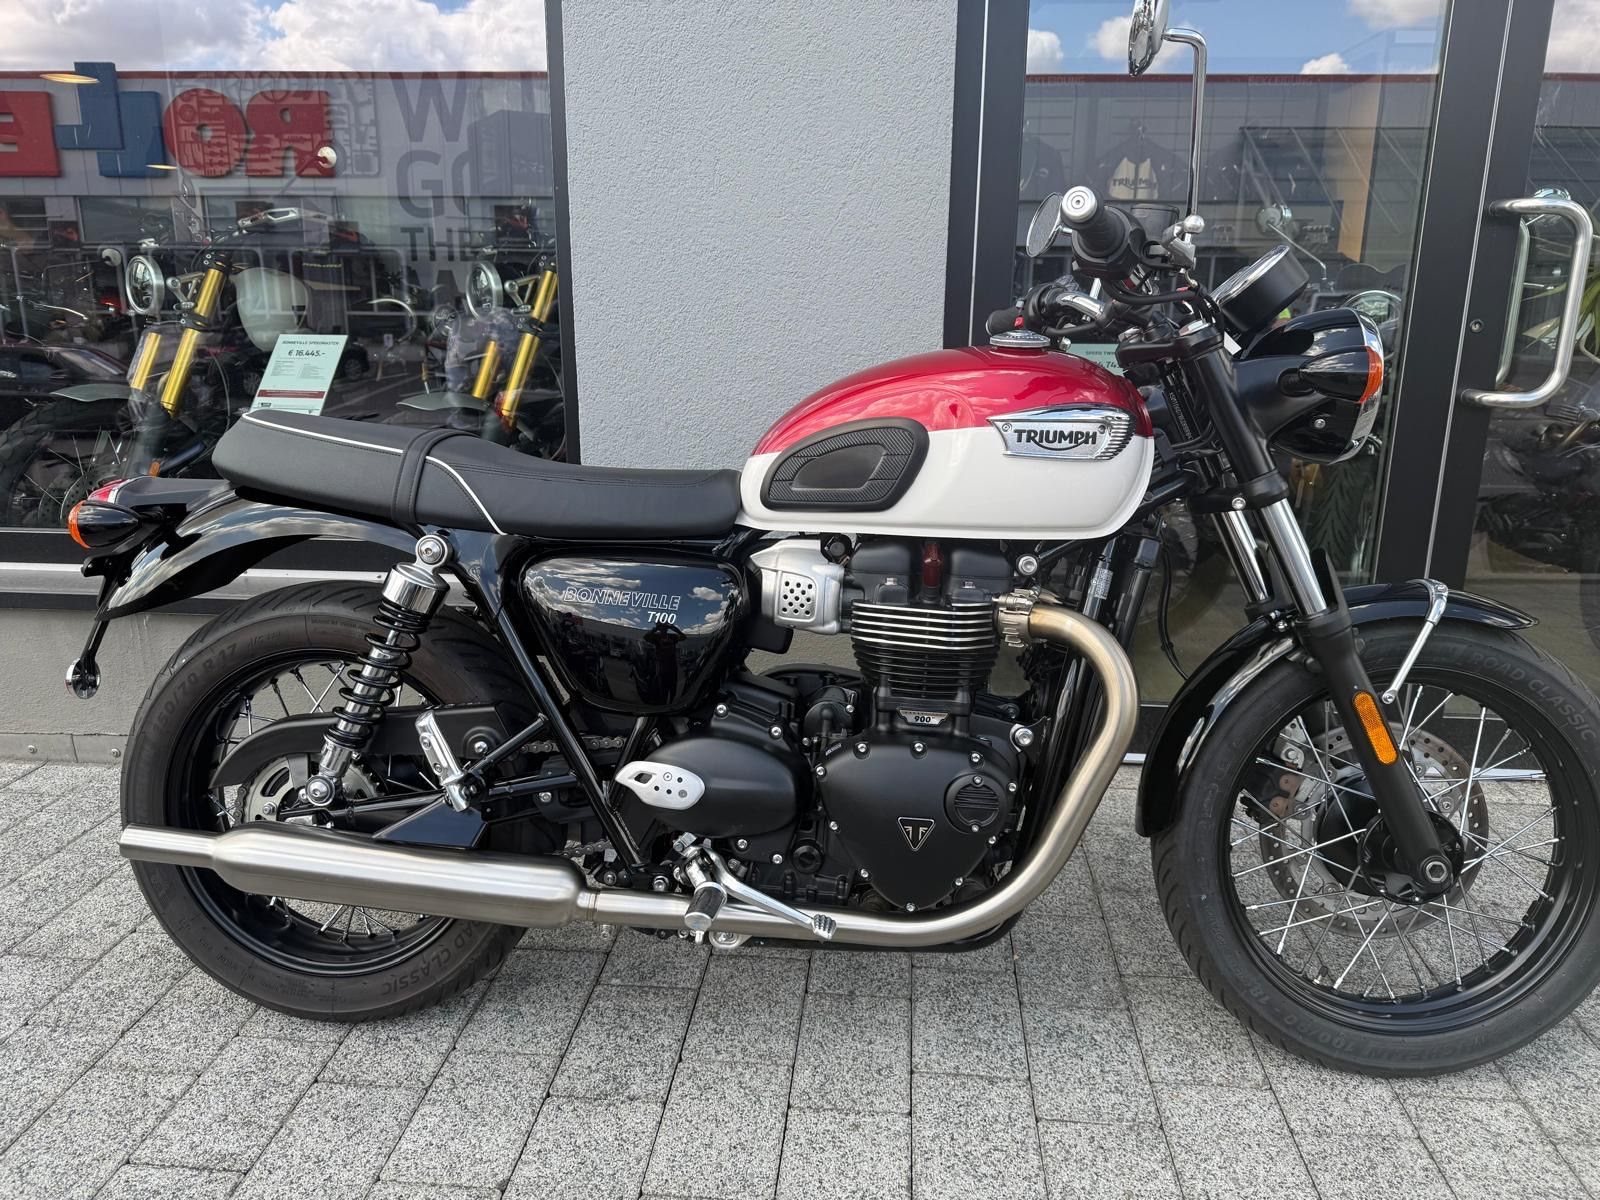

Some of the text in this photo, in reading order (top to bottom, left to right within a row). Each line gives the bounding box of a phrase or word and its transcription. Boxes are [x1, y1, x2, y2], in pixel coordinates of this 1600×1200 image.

[1013, 428, 1098, 451] TRIUMPH
[563, 586, 681, 611] BONNEVILLE
[647, 611, 677, 625] T100
[218, 642, 237, 660] 17
[1471, 652, 1597, 742] ROAD CLASSIC
[914, 715, 931, 723] 900
[381, 920, 480, 996] AD CLASSIC
